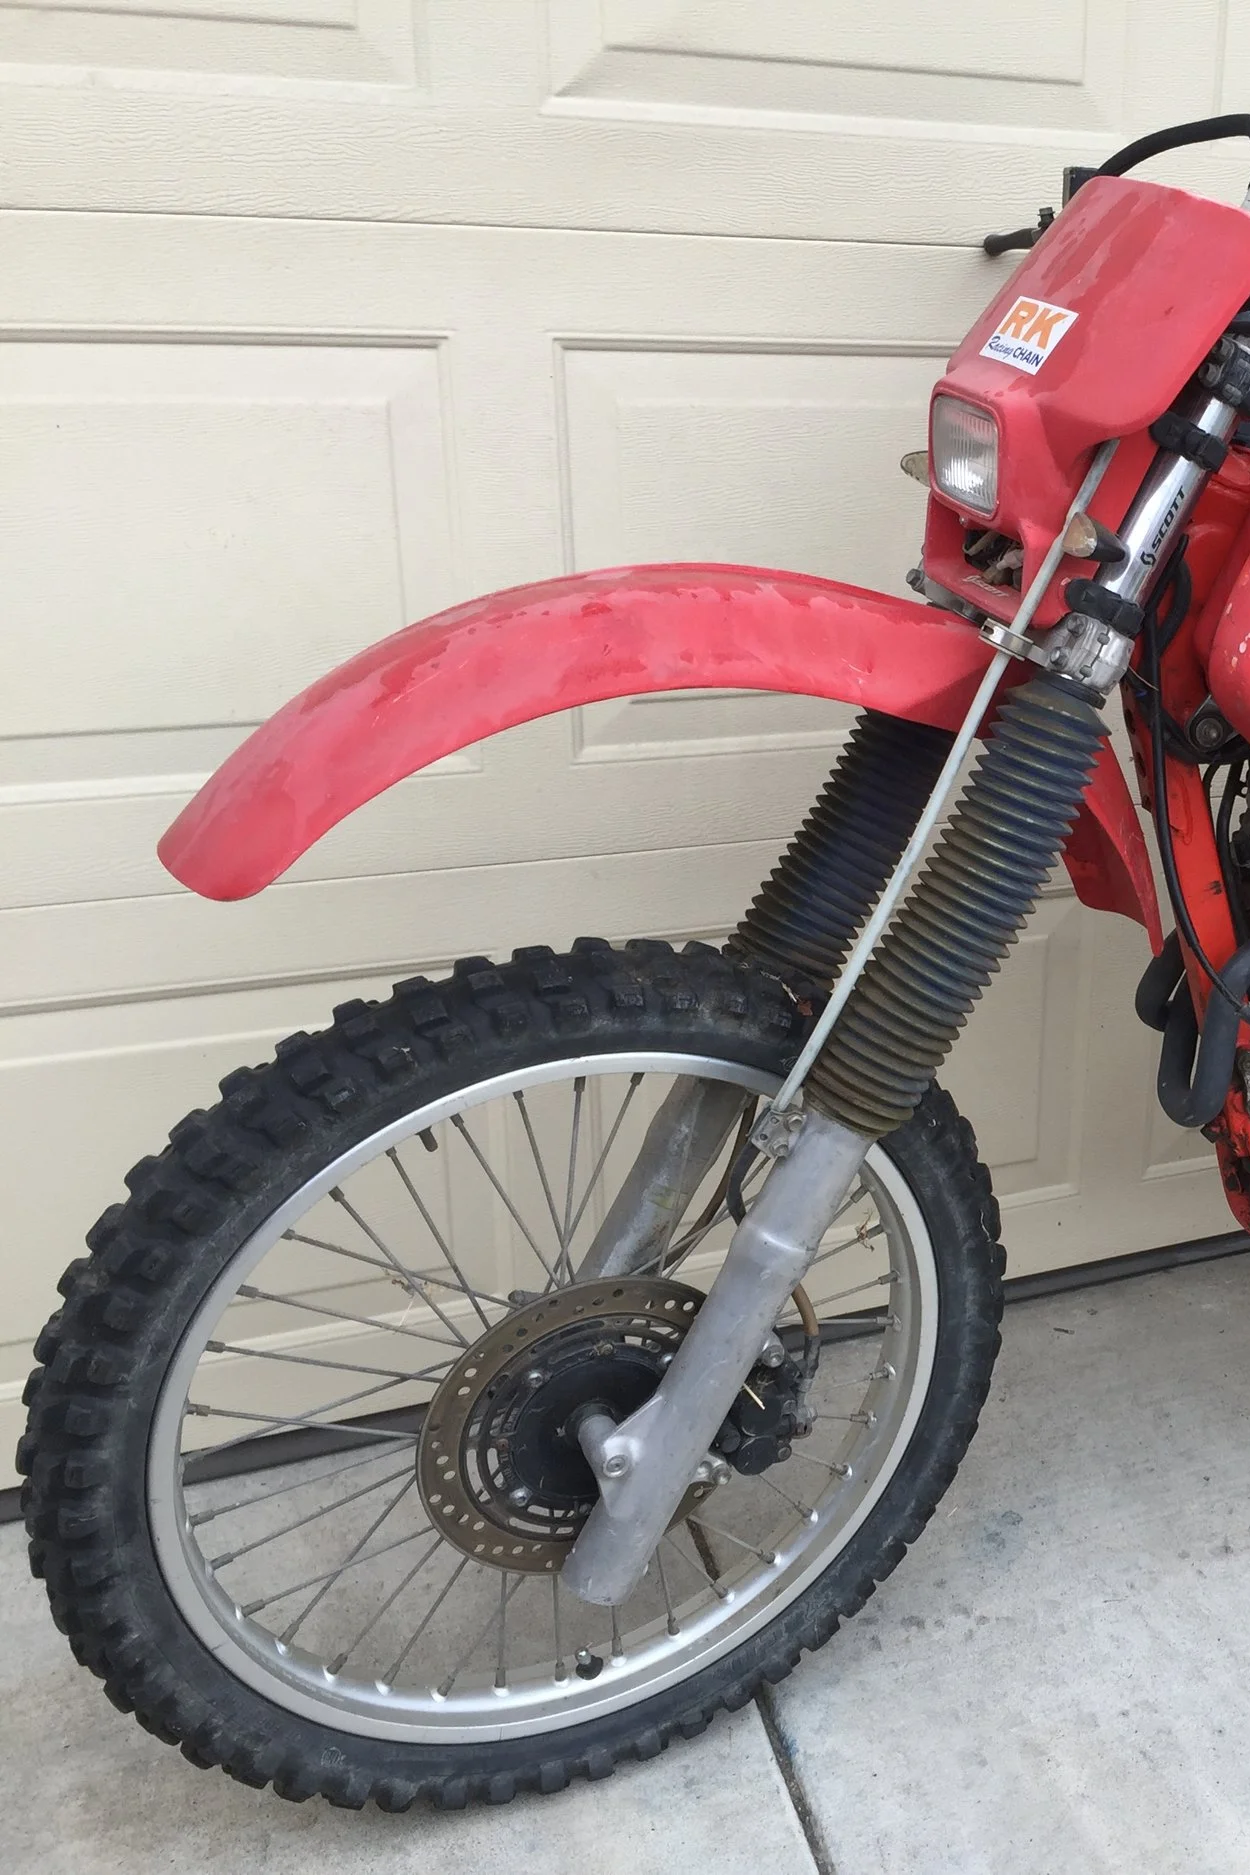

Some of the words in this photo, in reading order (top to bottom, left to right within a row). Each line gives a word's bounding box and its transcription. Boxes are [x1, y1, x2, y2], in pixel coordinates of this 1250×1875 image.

[998, 300, 1069, 350] RK
[988, 336, 1014, 360] Racing
[1012, 346, 1044, 368] CHAIN
[1151, 485, 1185, 553] SCOTT
